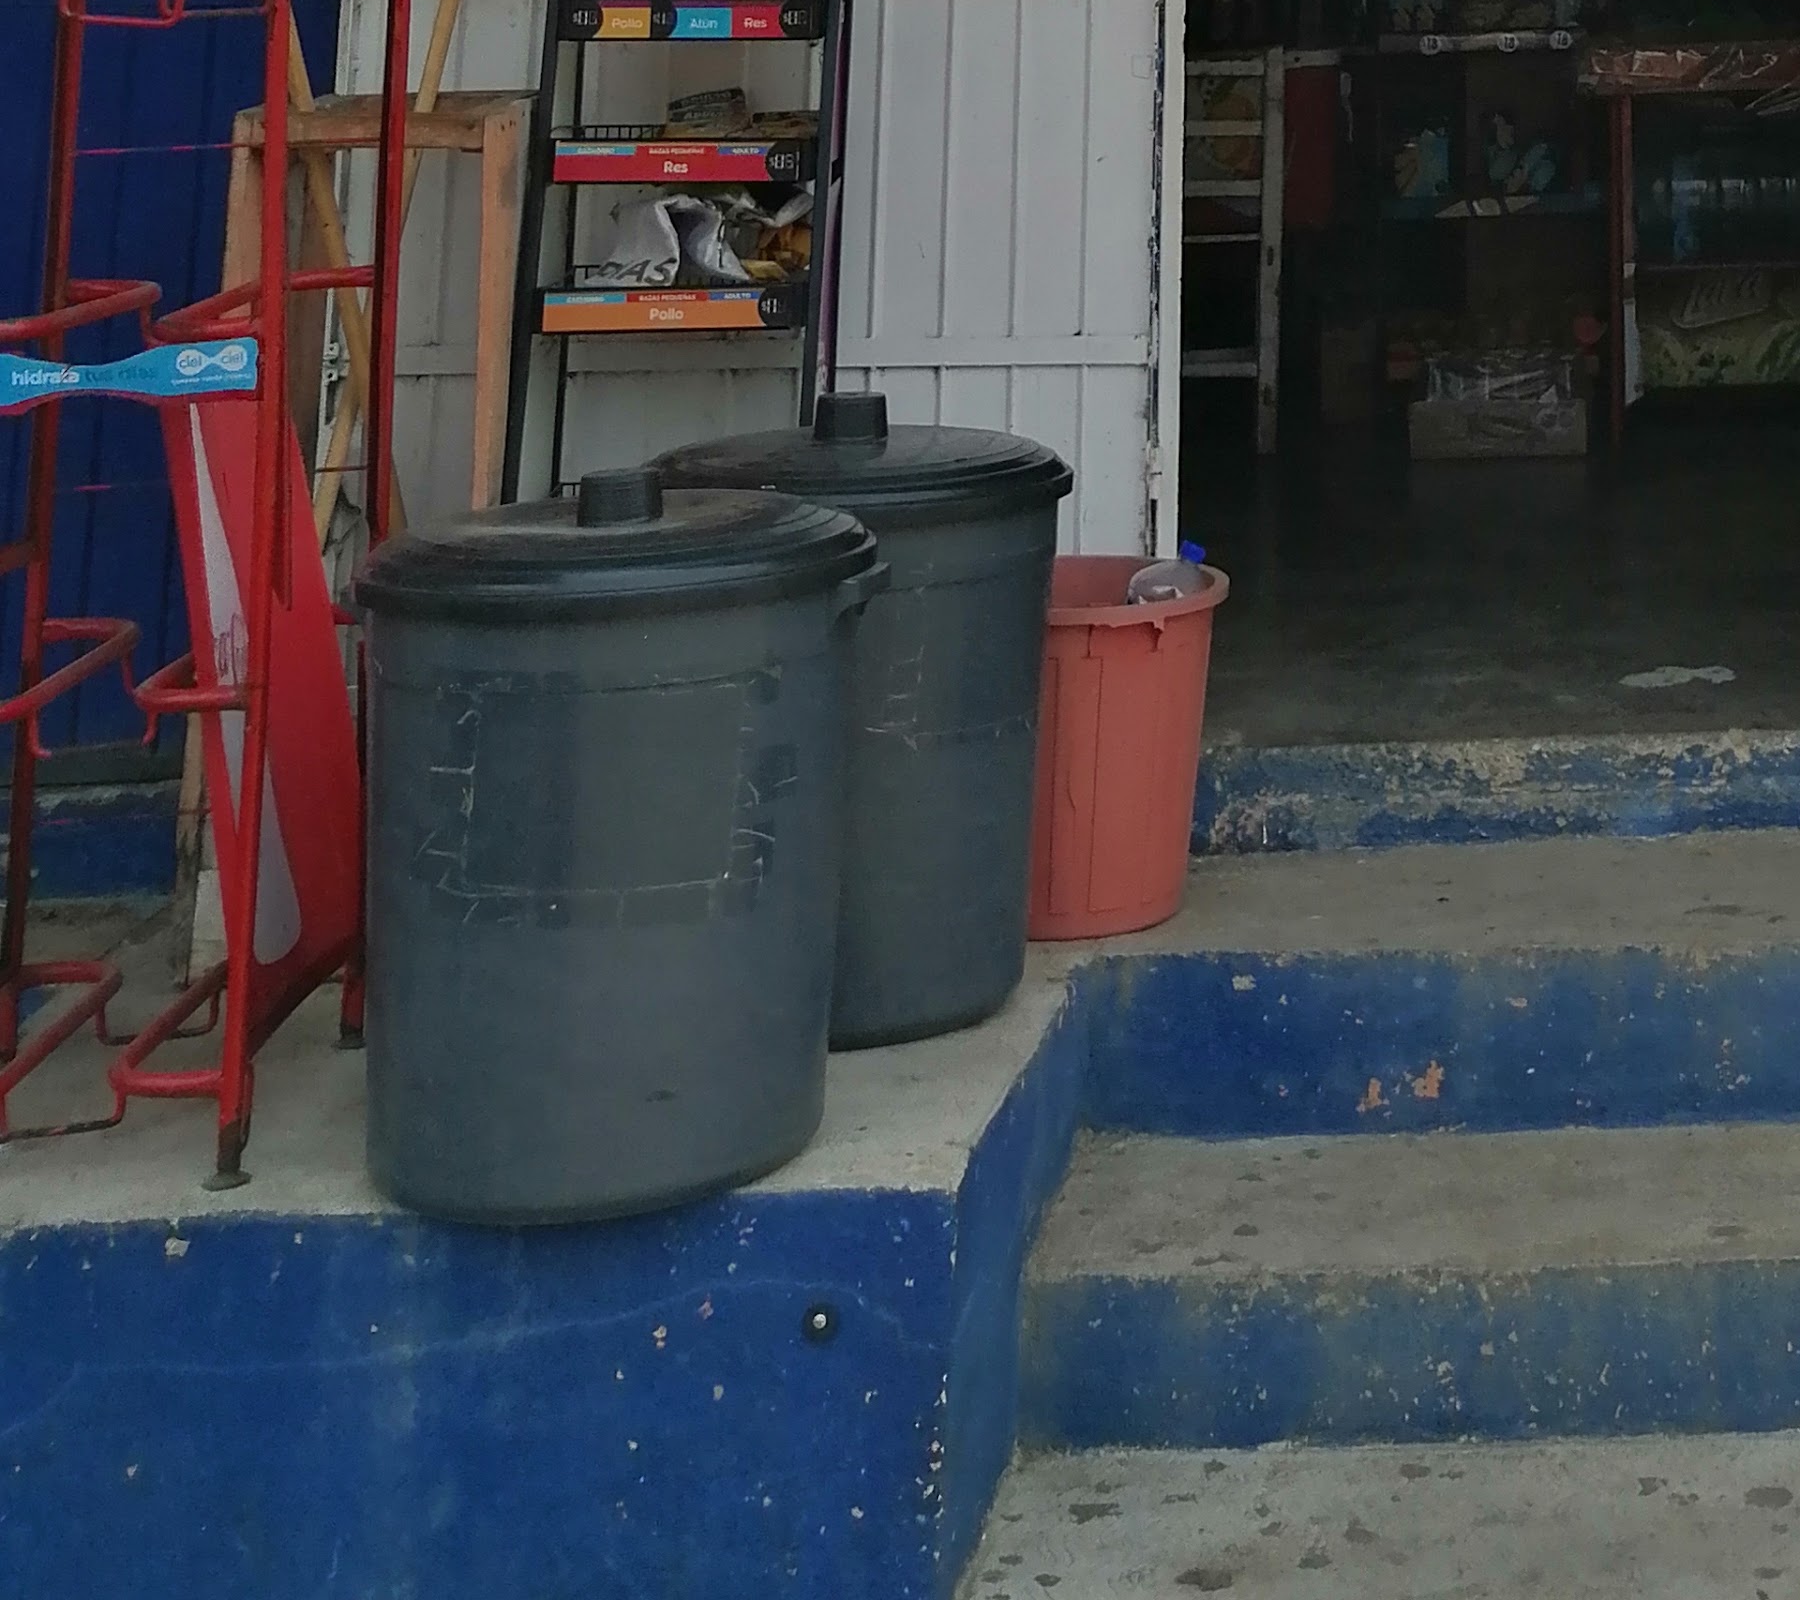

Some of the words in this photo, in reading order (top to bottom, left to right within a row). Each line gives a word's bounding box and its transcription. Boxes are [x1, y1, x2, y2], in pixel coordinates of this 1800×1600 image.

[743, 17, 768, 29] Res
[663, 161, 689, 174] Res
[649, 308, 684, 321] Pollo
